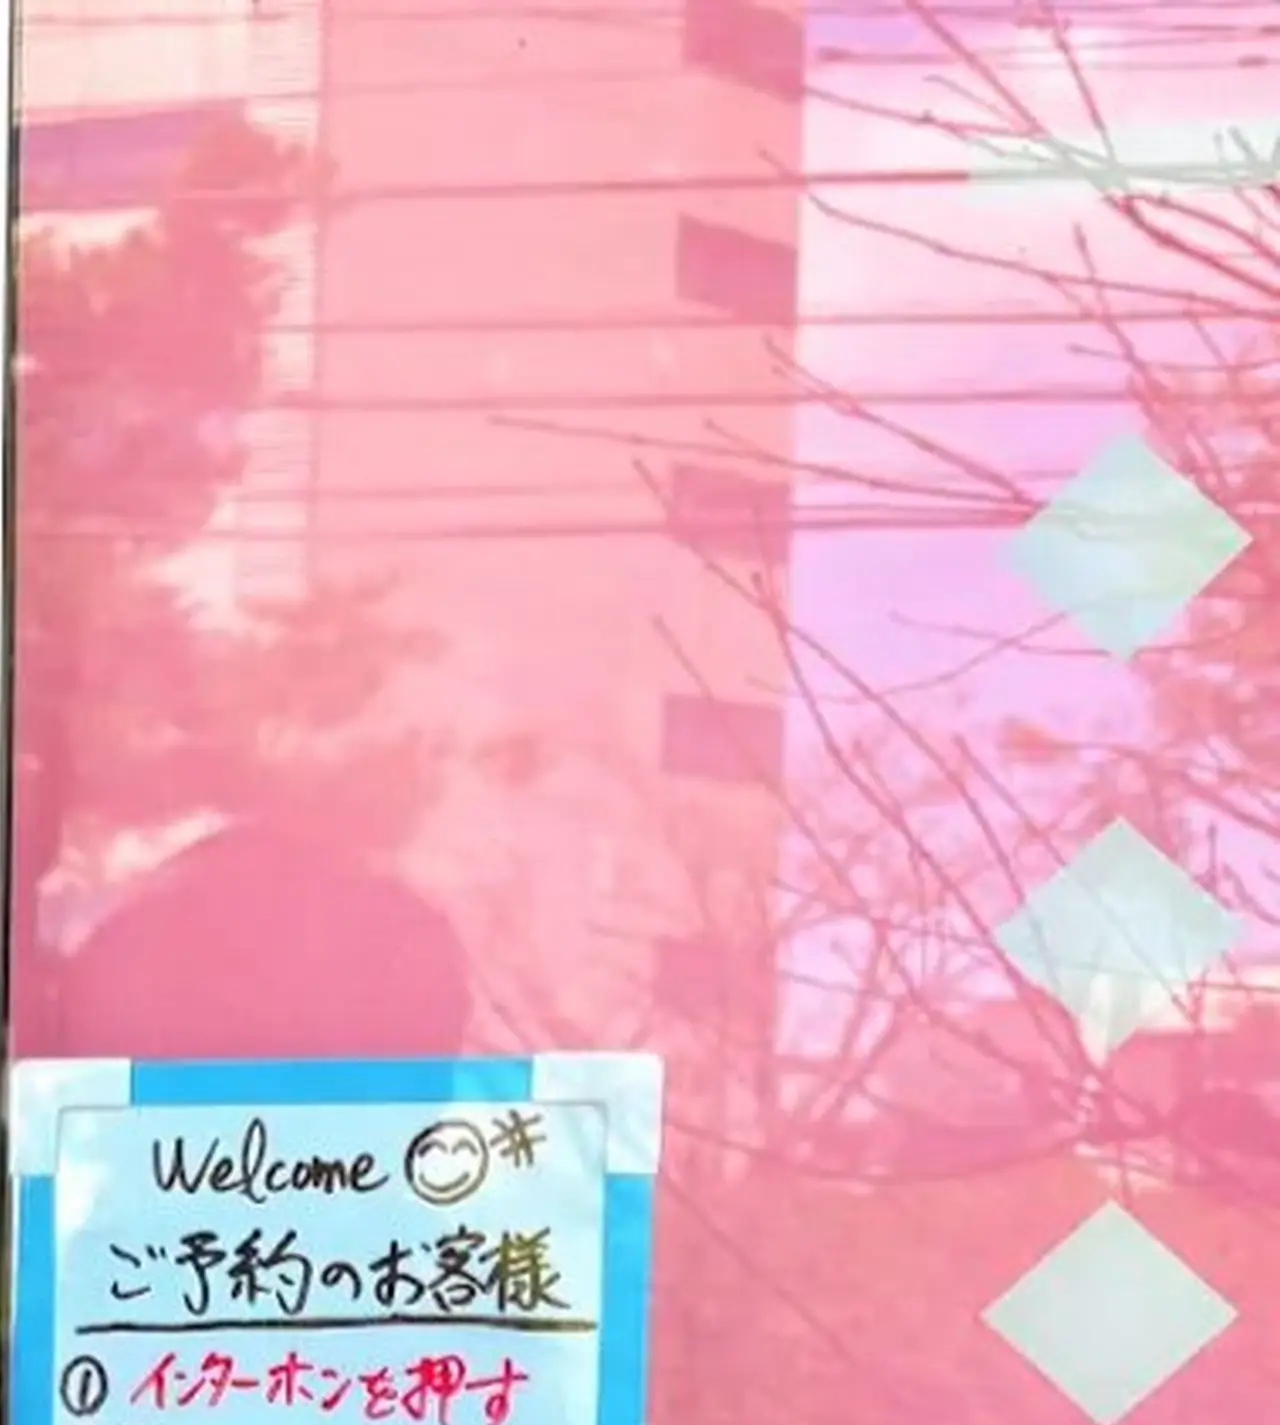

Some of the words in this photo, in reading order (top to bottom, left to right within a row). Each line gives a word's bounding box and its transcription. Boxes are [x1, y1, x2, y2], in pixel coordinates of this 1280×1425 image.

[152, 1117, 389, 1203] Welcome
[110, 1224, 572, 1316] ご予約のお客様
